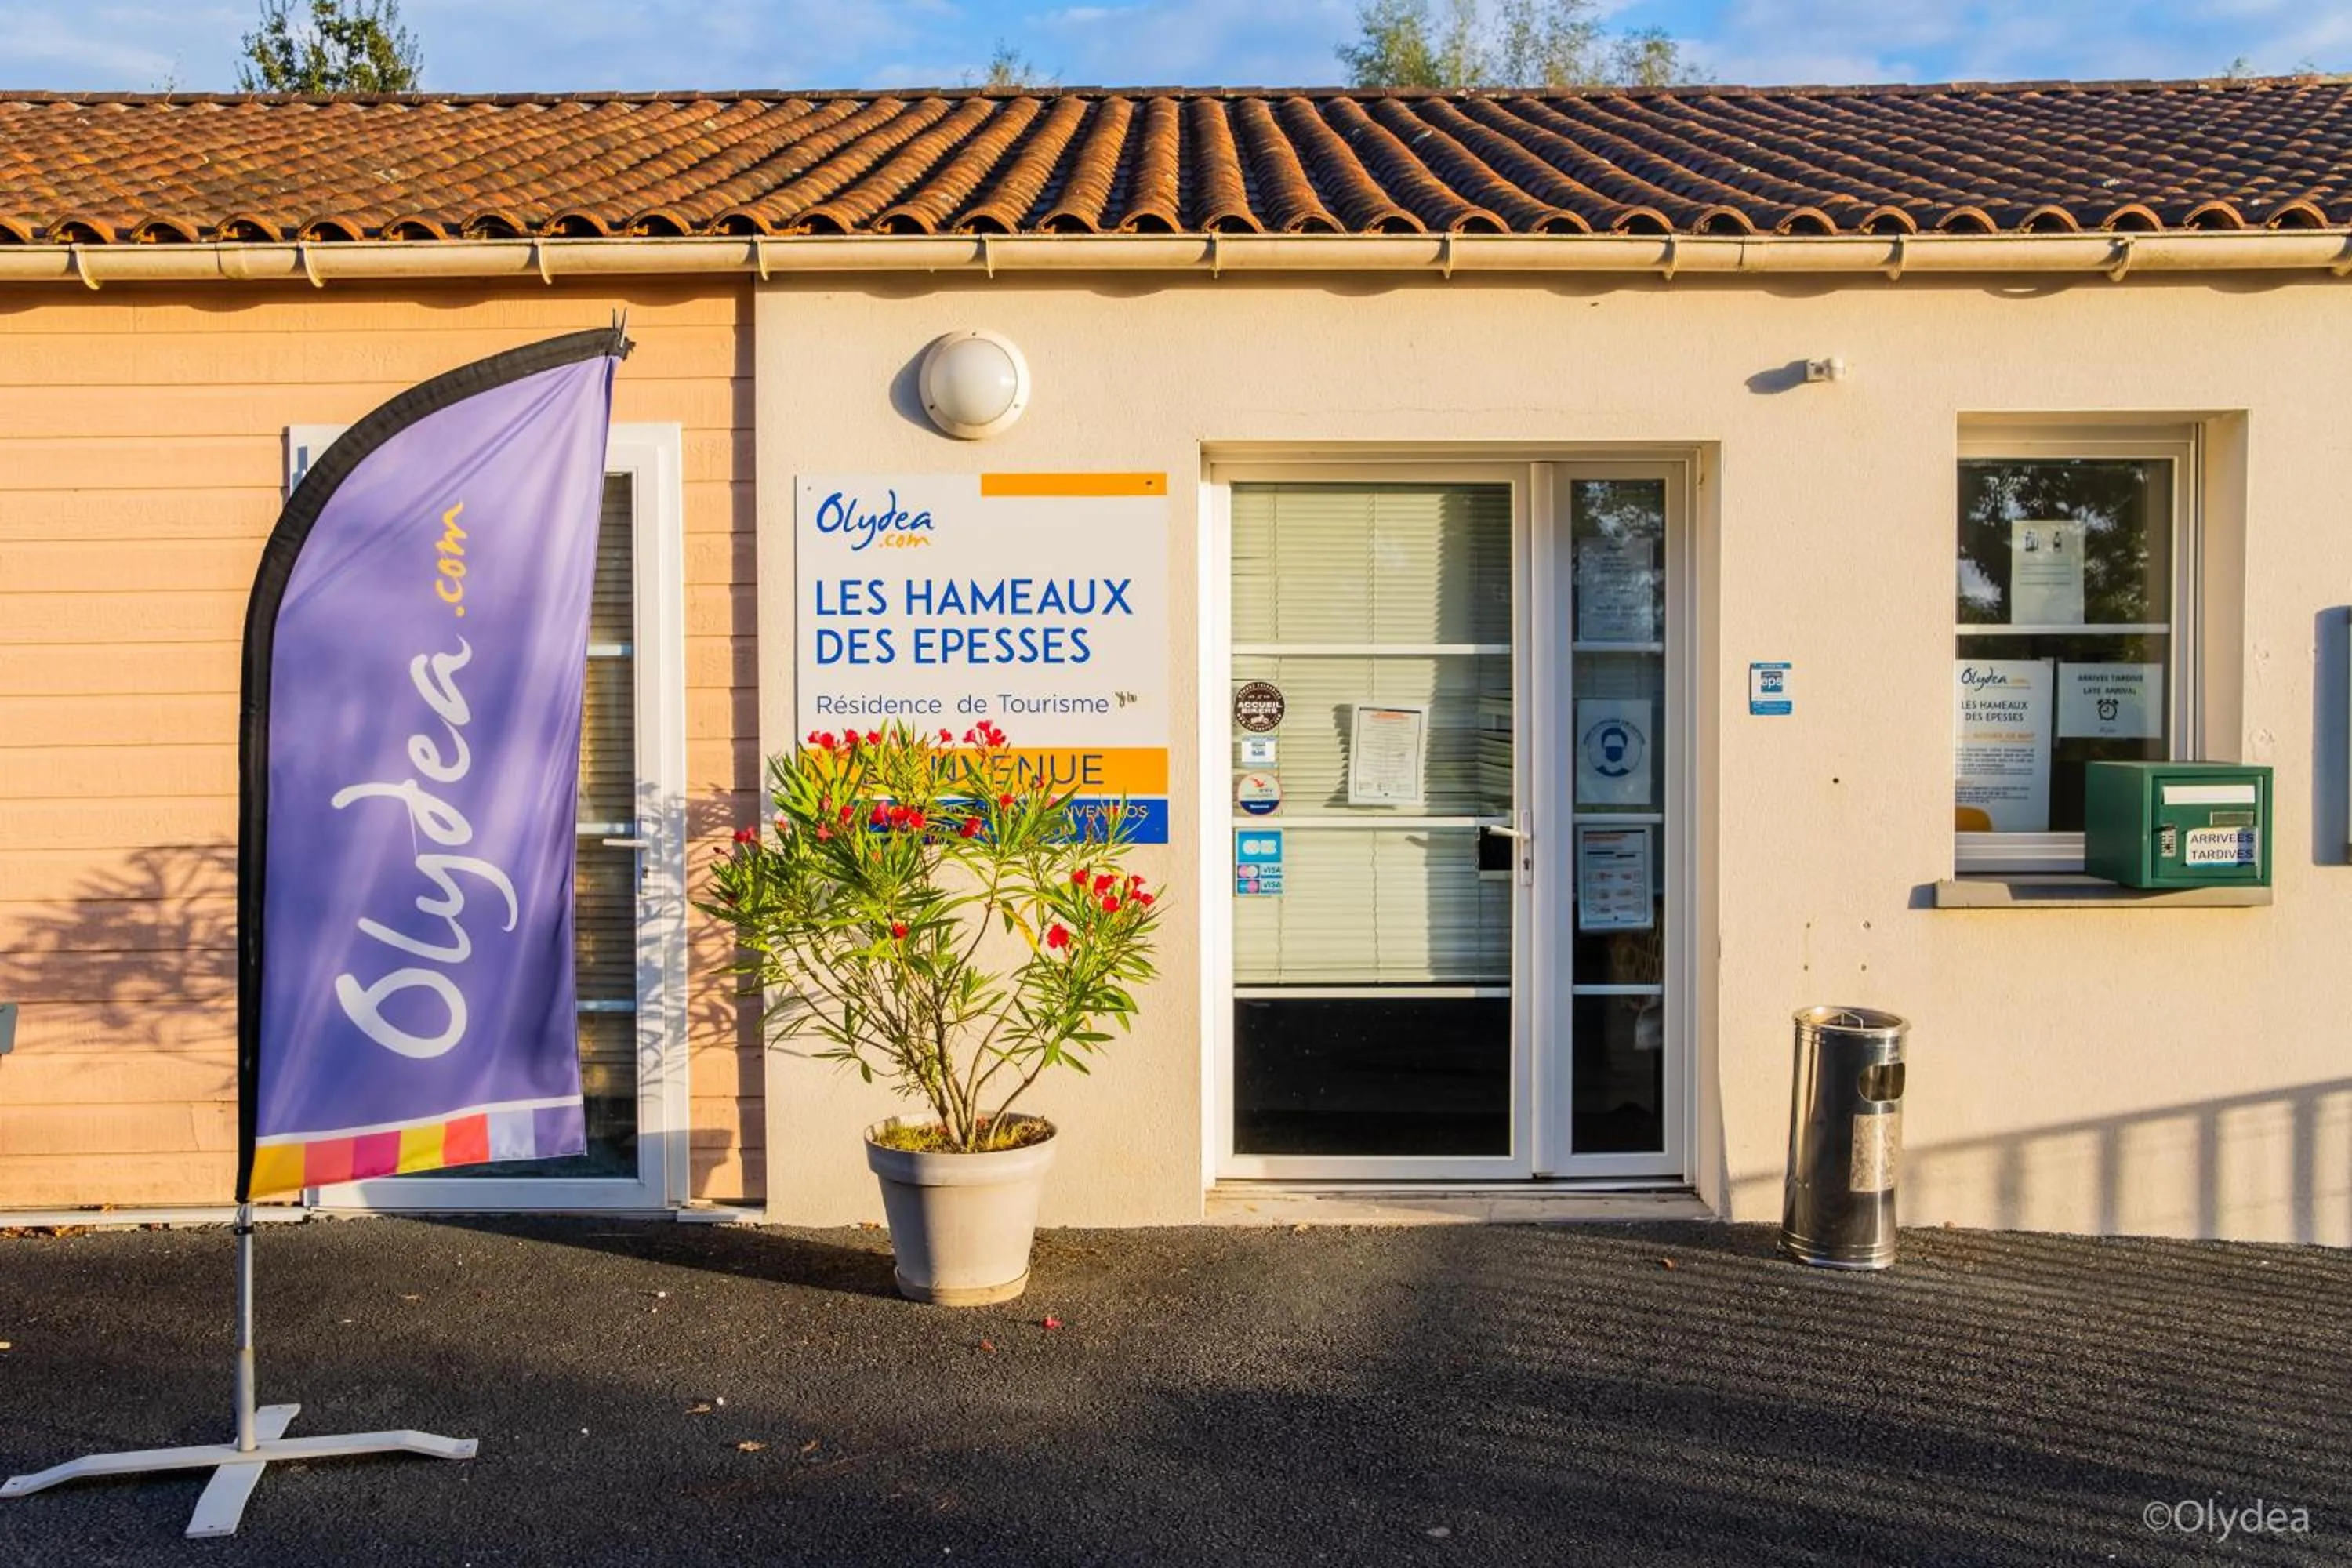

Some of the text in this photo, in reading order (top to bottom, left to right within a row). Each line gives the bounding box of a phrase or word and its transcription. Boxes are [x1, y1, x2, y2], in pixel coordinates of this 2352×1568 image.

[816, 489, 935, 551] Olydea
[878, 534, 931, 547] .com
[816, 579, 1134, 615] LES HAMEAUX
[816, 627, 1091, 665] DES EPESSES
[816, 694, 942, 715] Résidence
[956, 694, 988, 713] de
[997, 693, 1109, 713] Tourisme
[1961, 701, 1977, 710] LES
[331, 501, 518, 1059] Olydea .com
[2191, 848, 2254, 861] TARDIVES
